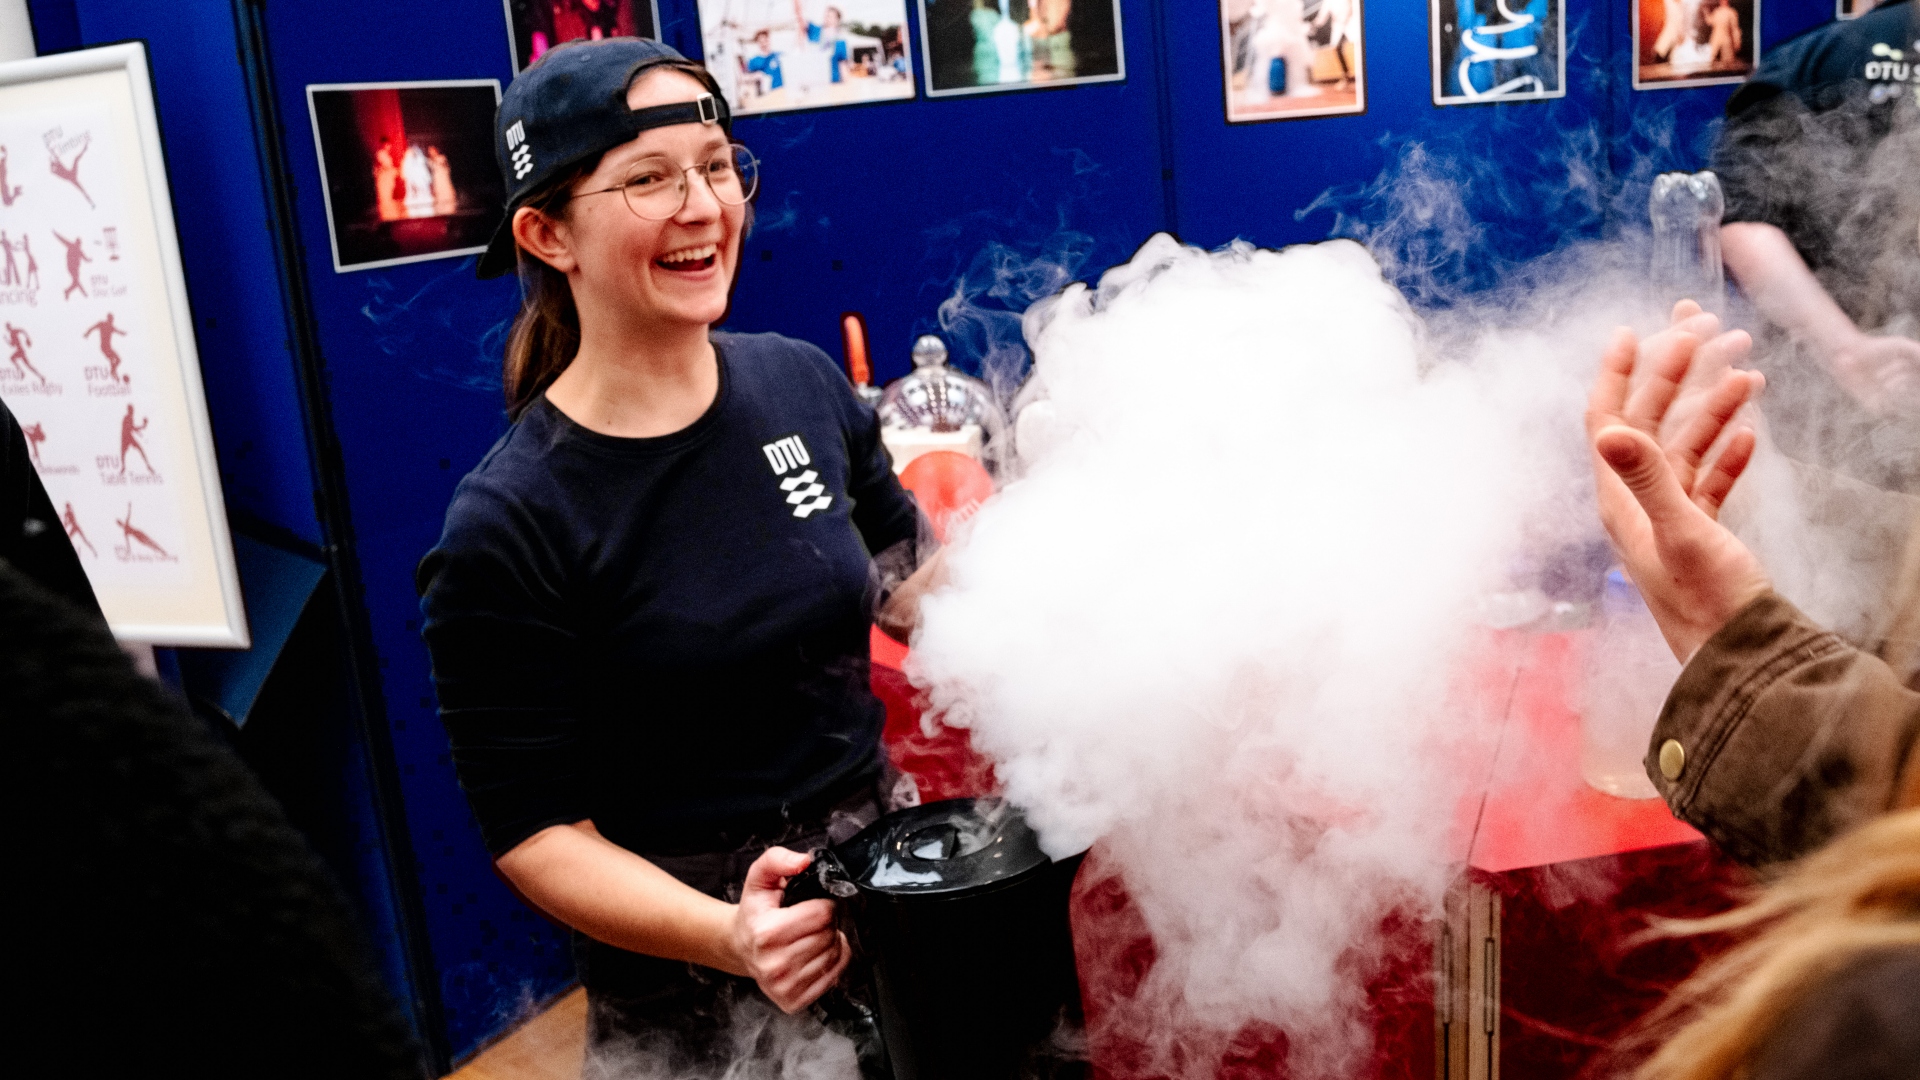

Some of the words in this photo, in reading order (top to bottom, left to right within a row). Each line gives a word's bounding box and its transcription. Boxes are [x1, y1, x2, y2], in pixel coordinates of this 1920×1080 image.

[1865, 61, 1910, 81] DTU
[506, 120, 525, 151] DTU
[84, 366, 109, 381] DTU
[95, 454, 119, 469] DTU
[763, 435, 810, 475] DTU
